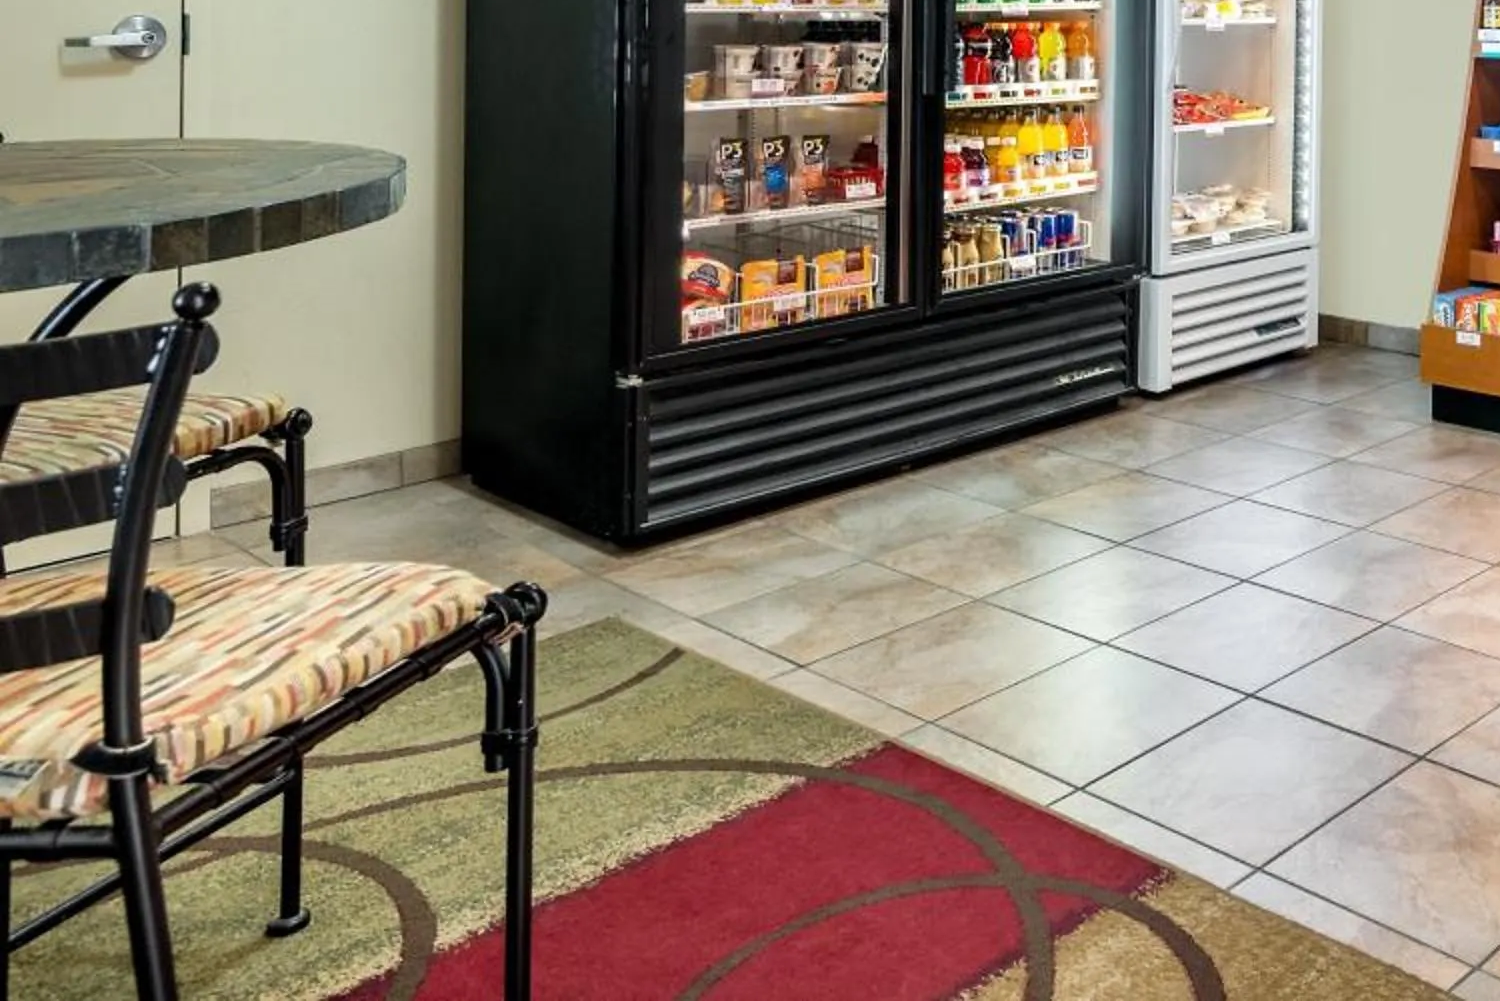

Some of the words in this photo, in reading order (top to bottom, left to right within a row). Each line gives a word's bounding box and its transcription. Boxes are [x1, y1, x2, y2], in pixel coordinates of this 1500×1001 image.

[721, 140, 743, 160] P3
[764, 139, 786, 159] P3
[803, 137, 824, 156] P3
